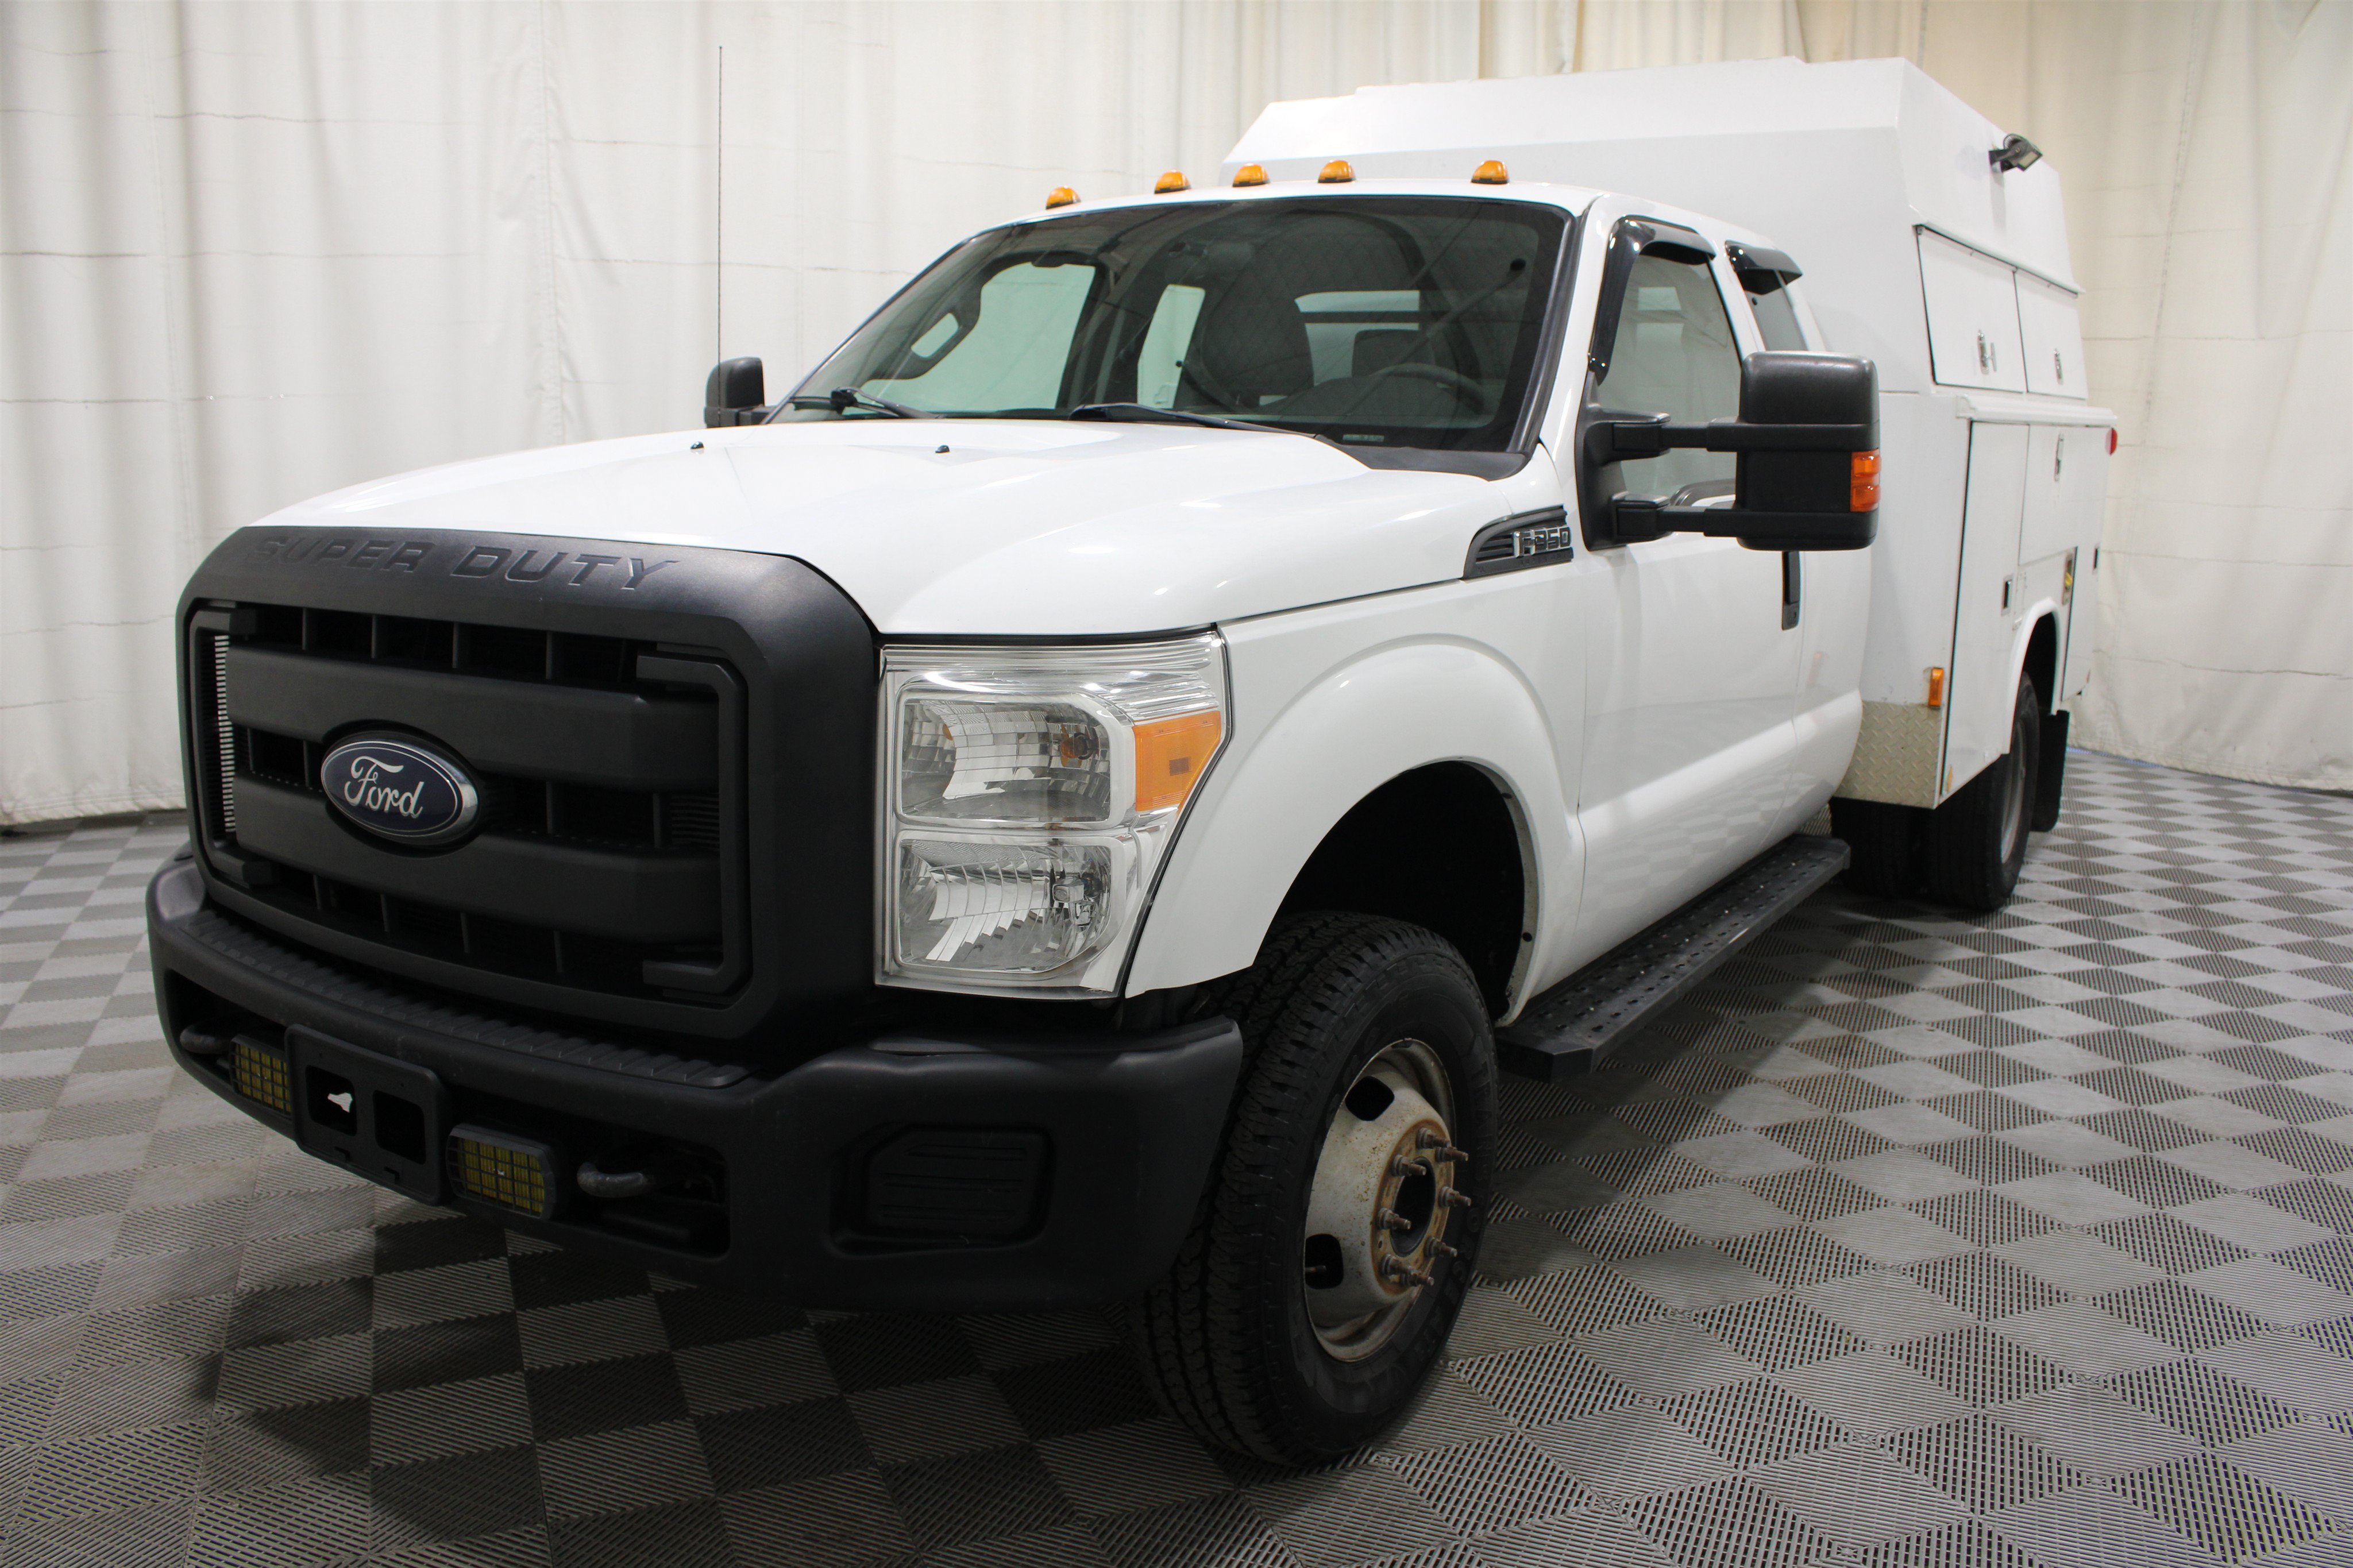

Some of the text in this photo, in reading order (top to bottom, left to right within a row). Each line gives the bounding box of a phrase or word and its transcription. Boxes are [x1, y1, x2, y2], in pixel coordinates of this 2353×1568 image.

[258, 535, 681, 590] SUPER DUTY
[344, 755, 425, 819] Ford
